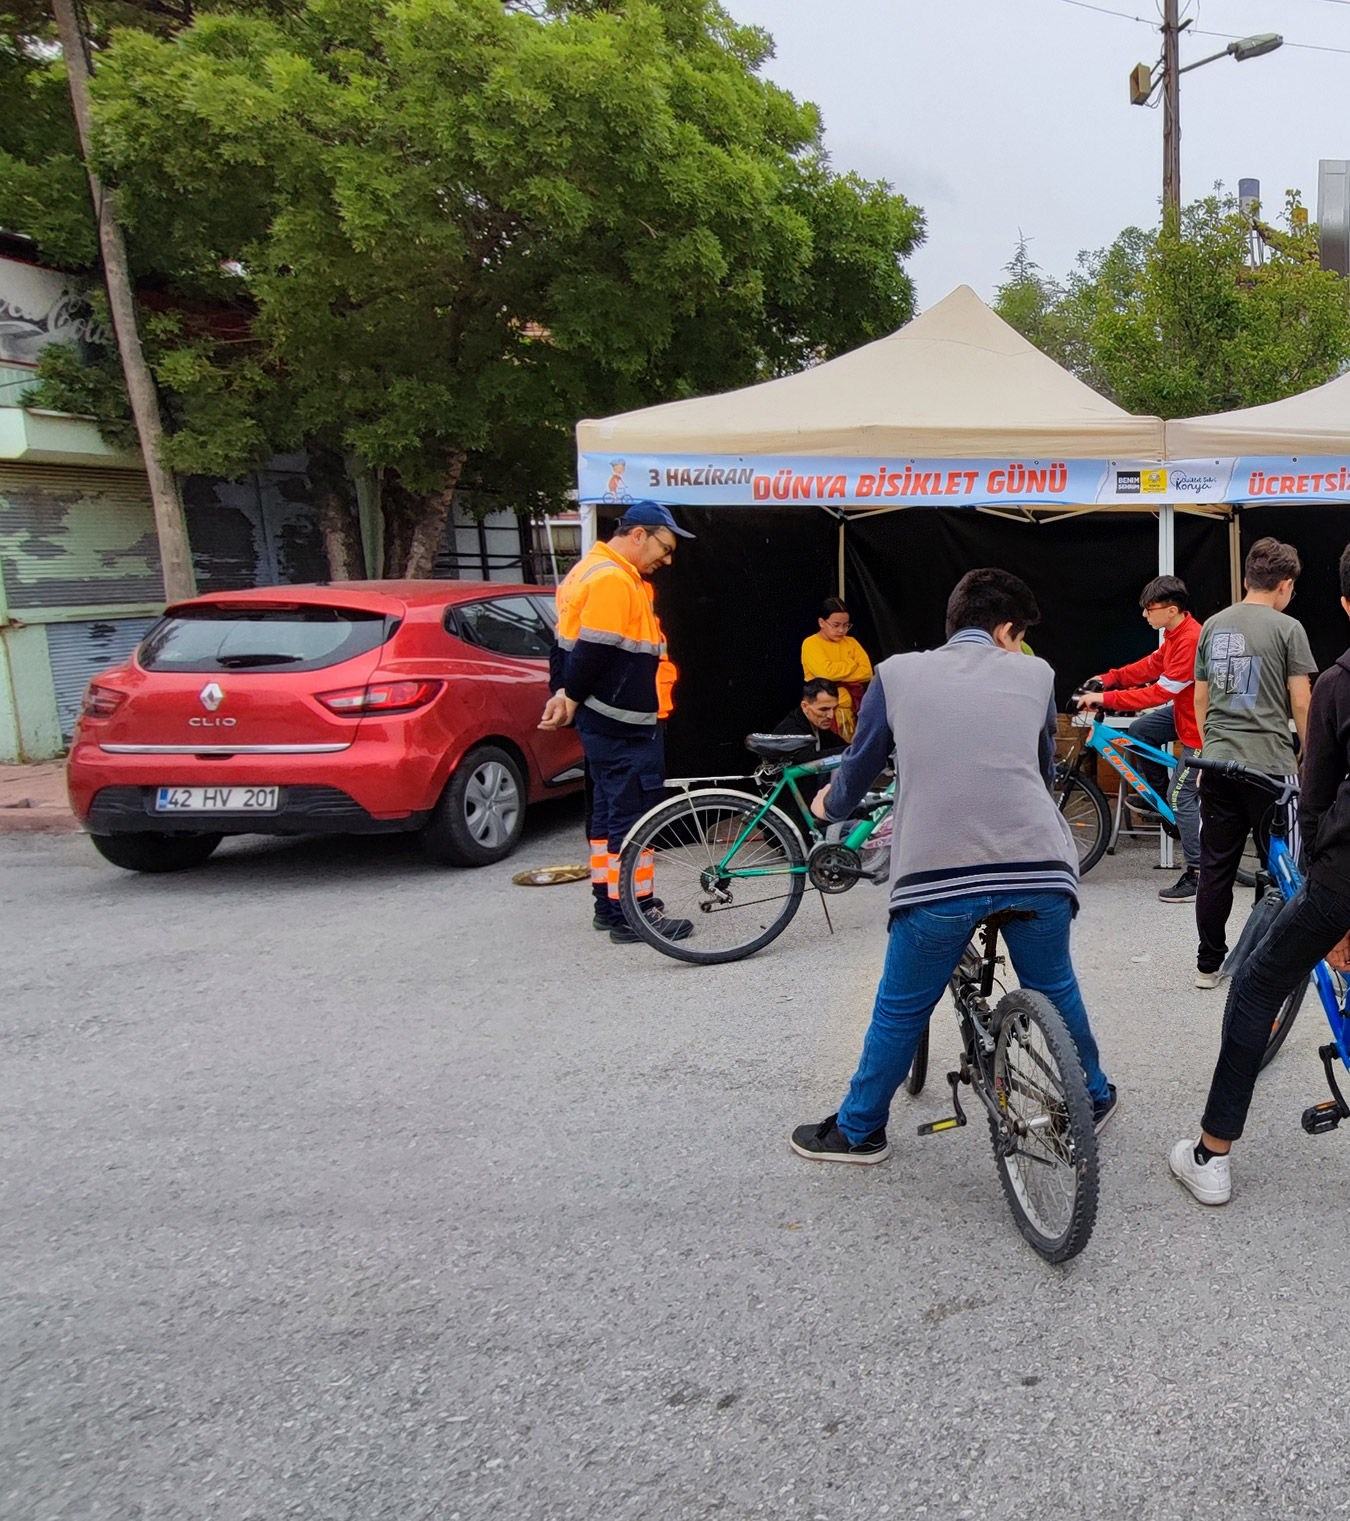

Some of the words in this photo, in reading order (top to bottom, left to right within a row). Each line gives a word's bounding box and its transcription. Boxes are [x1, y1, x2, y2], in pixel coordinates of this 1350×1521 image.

[649, 468, 660, 487] 3
[666, 464, 754, 487] HAZİRAN
[753, 469, 847, 500] DÜNYA
[855, 466, 979, 497] BİSİKLET
[986, 463, 1067, 494] GÜNÜ
[1176, 478, 1212, 494] Konya
[188, 717, 237, 727] CLIO
[168, 789, 192, 807] 42
[202, 789, 232, 807] HV
[243, 789, 276, 807] 201
